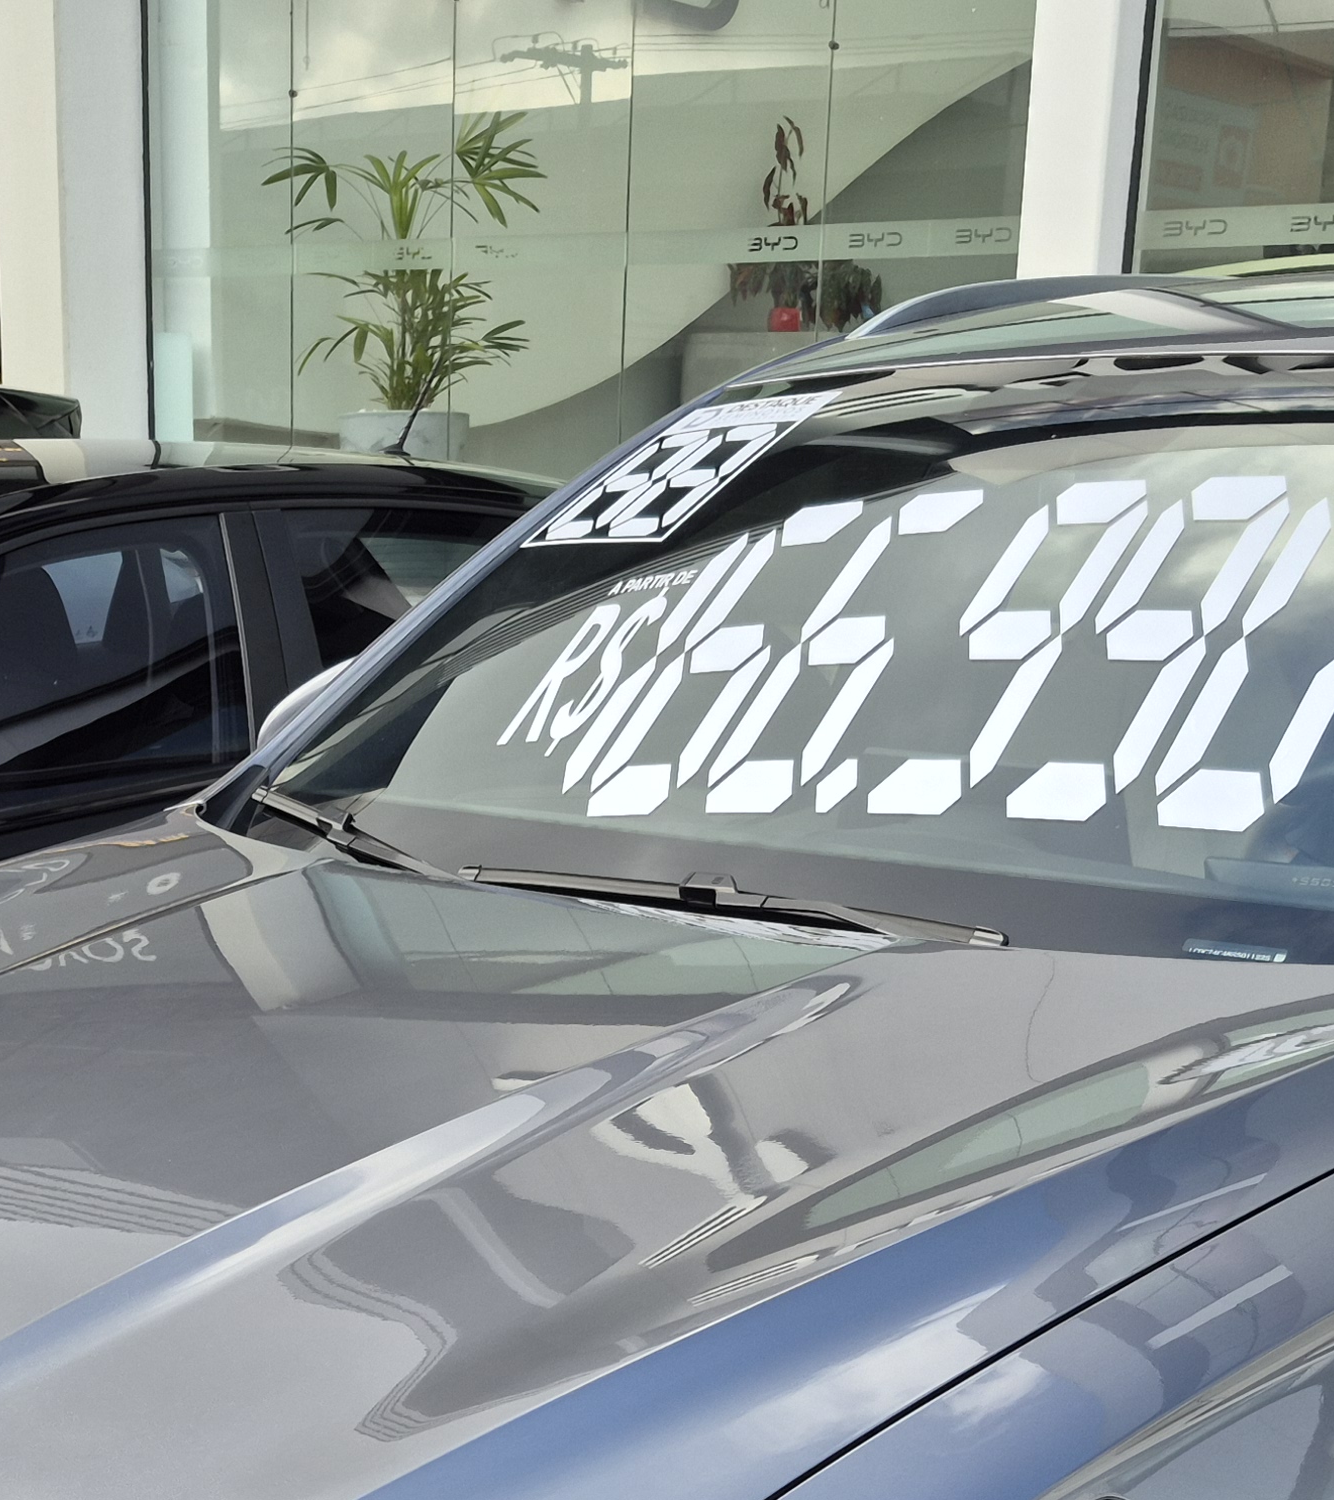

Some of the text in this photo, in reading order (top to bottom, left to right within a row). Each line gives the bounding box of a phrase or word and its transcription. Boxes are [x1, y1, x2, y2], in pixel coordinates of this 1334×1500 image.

[955, 226, 1013, 245] BYD
[1161, 218, 1228, 238] BYD
[747, 235, 799, 252] BYD
[848, 231, 903, 249] BYD
[728, 396, 822, 413] DESTAQUE
[607, 568, 699, 597] A PARTIR DE
